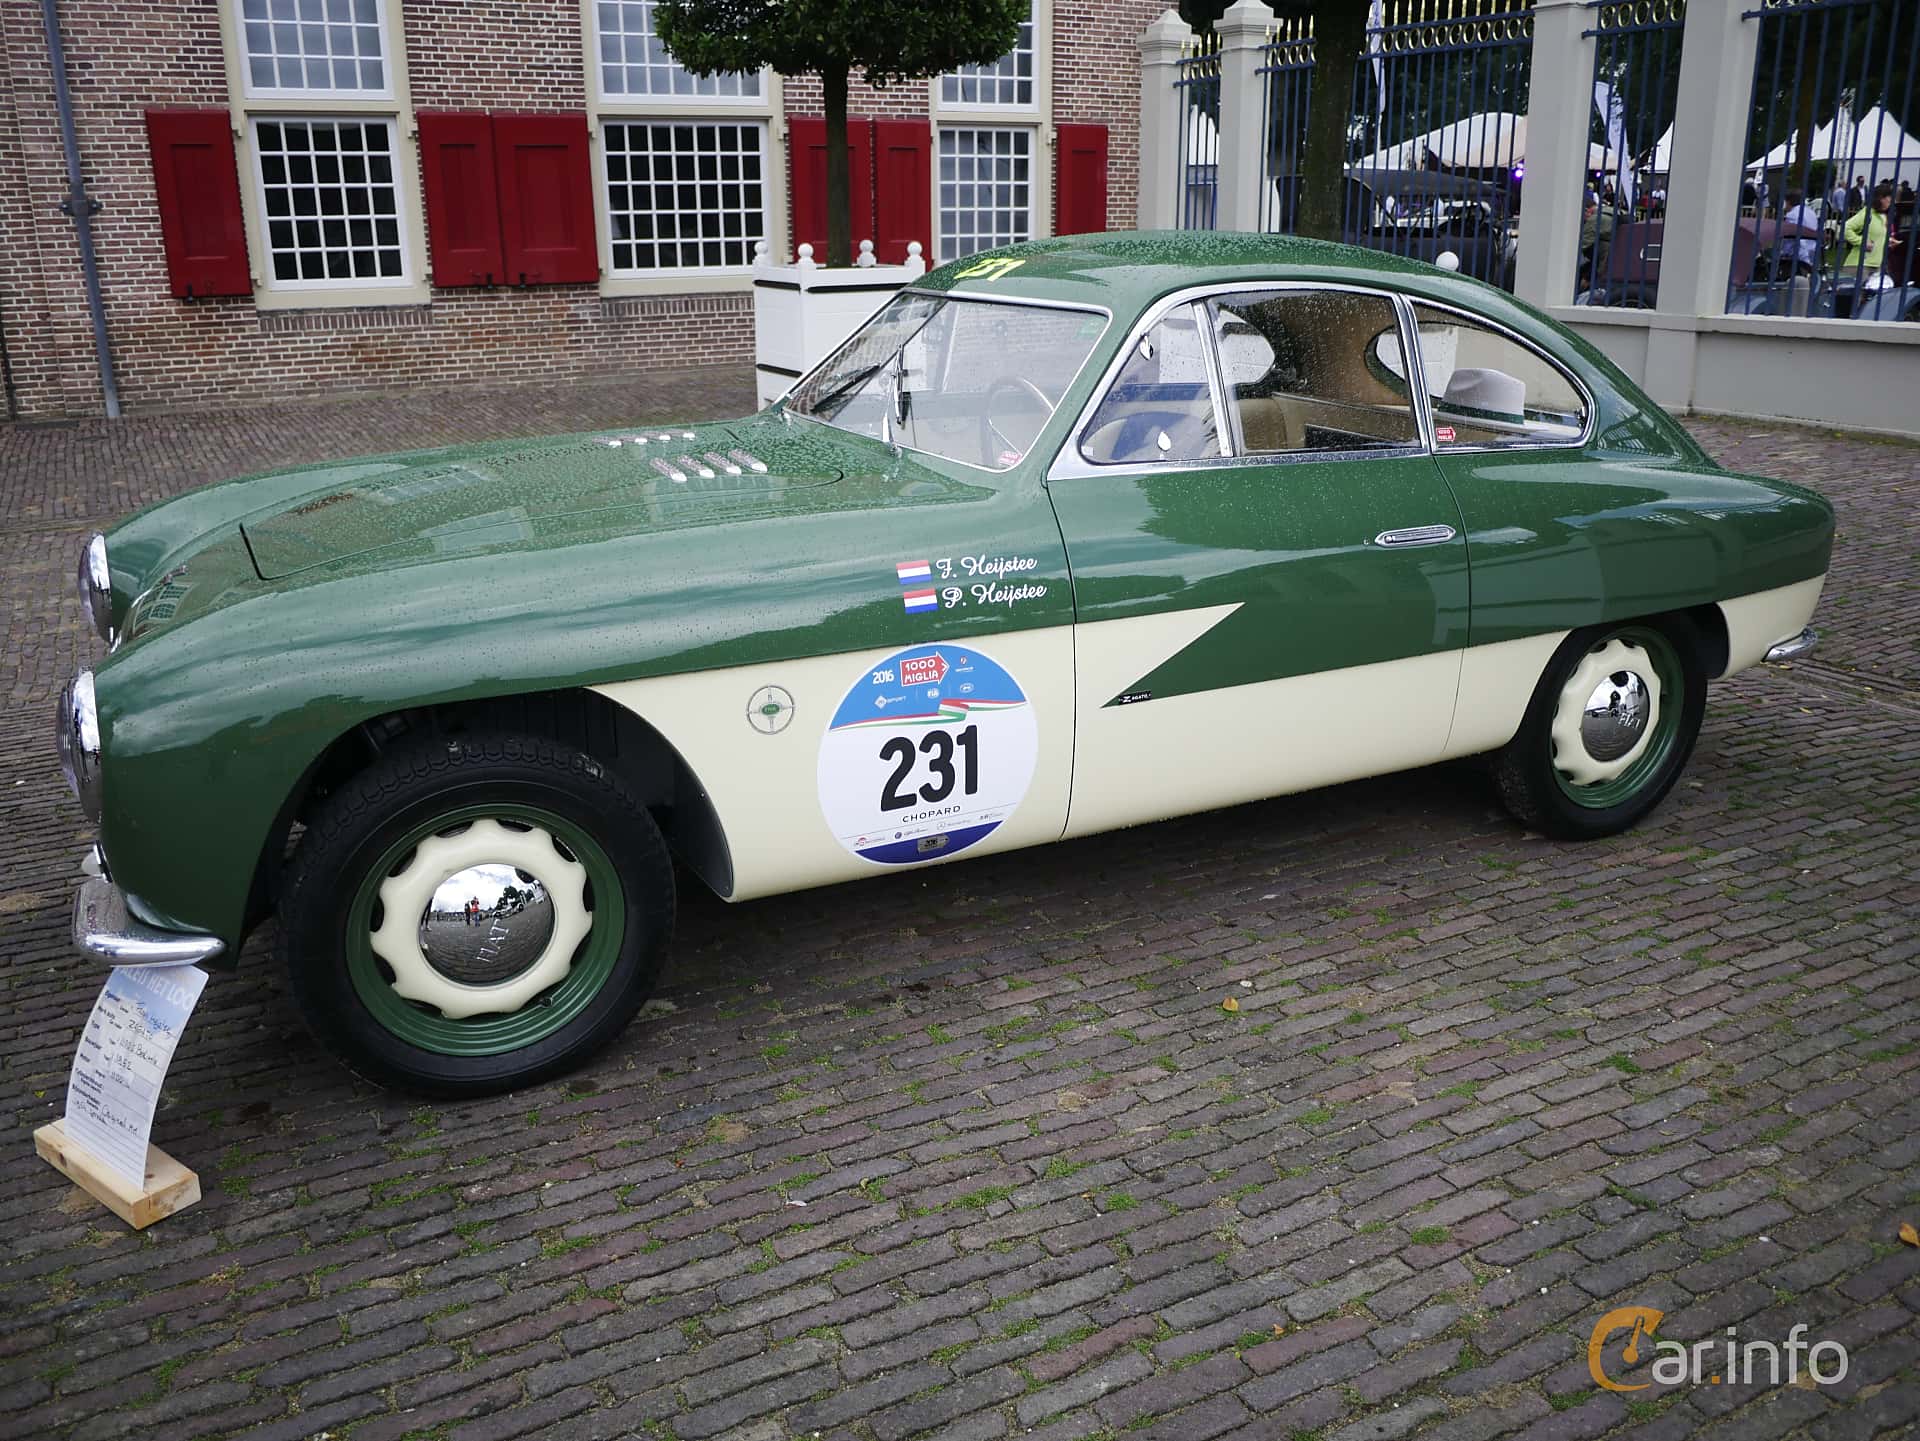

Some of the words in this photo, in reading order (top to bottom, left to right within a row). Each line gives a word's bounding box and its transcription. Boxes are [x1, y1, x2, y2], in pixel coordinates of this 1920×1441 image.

[961, 554, 1037, 579] Heijstee
[971, 582, 1047, 608] Heijstee
[905, 659, 936, 672] 1000
[872, 670, 895, 685] 2016
[904, 670, 939, 684] MIGLIA
[879, 724, 979, 812] 231
[902, 805, 961, 823] CHOPARD
